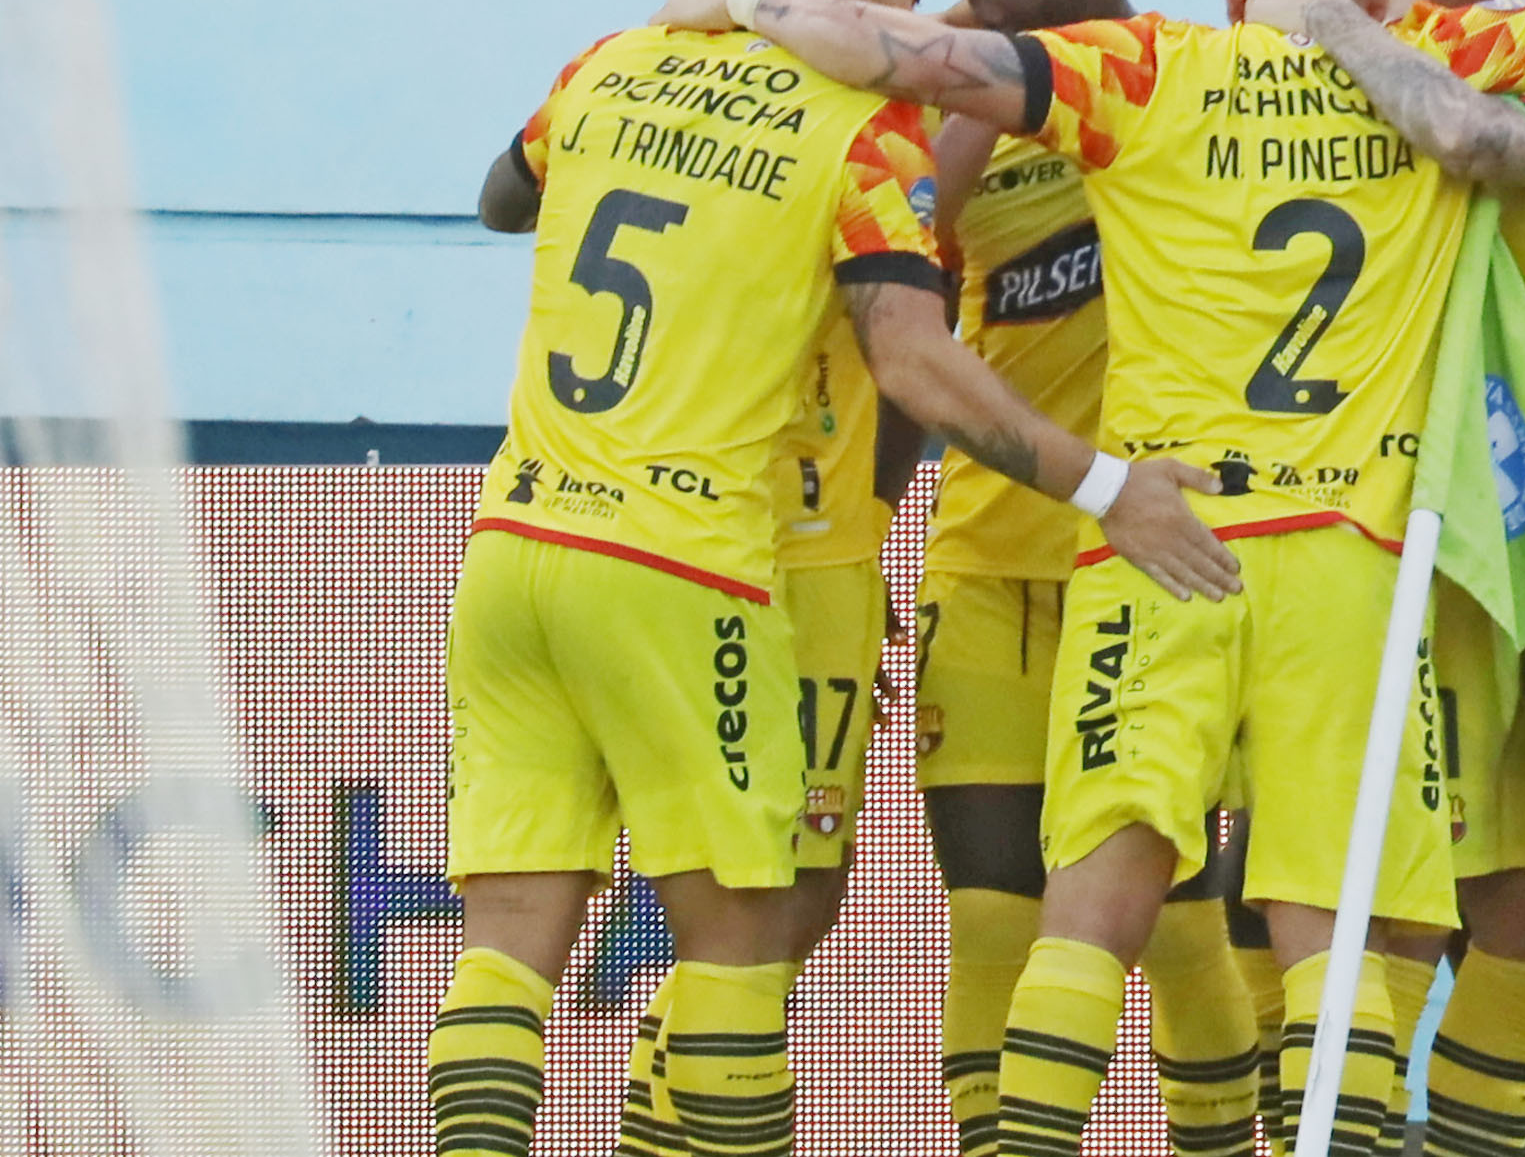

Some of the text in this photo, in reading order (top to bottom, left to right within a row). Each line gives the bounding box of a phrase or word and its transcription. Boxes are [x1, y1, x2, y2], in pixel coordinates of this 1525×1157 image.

[592, 72, 806, 134] PICHINCHA
[655, 54, 801, 94] BANCO
[561, 111, 798, 202] J. TRINDADE
[1206, 134, 1415, 181] M. PINEIDA
[547, 188, 690, 414] 5
[1245, 198, 1366, 415] 2
[646, 464, 721, 502] TCL
[714, 615, 750, 792] crecos
[798, 677, 858, 771] 17
[1075, 604, 1131, 772] RIVAL
